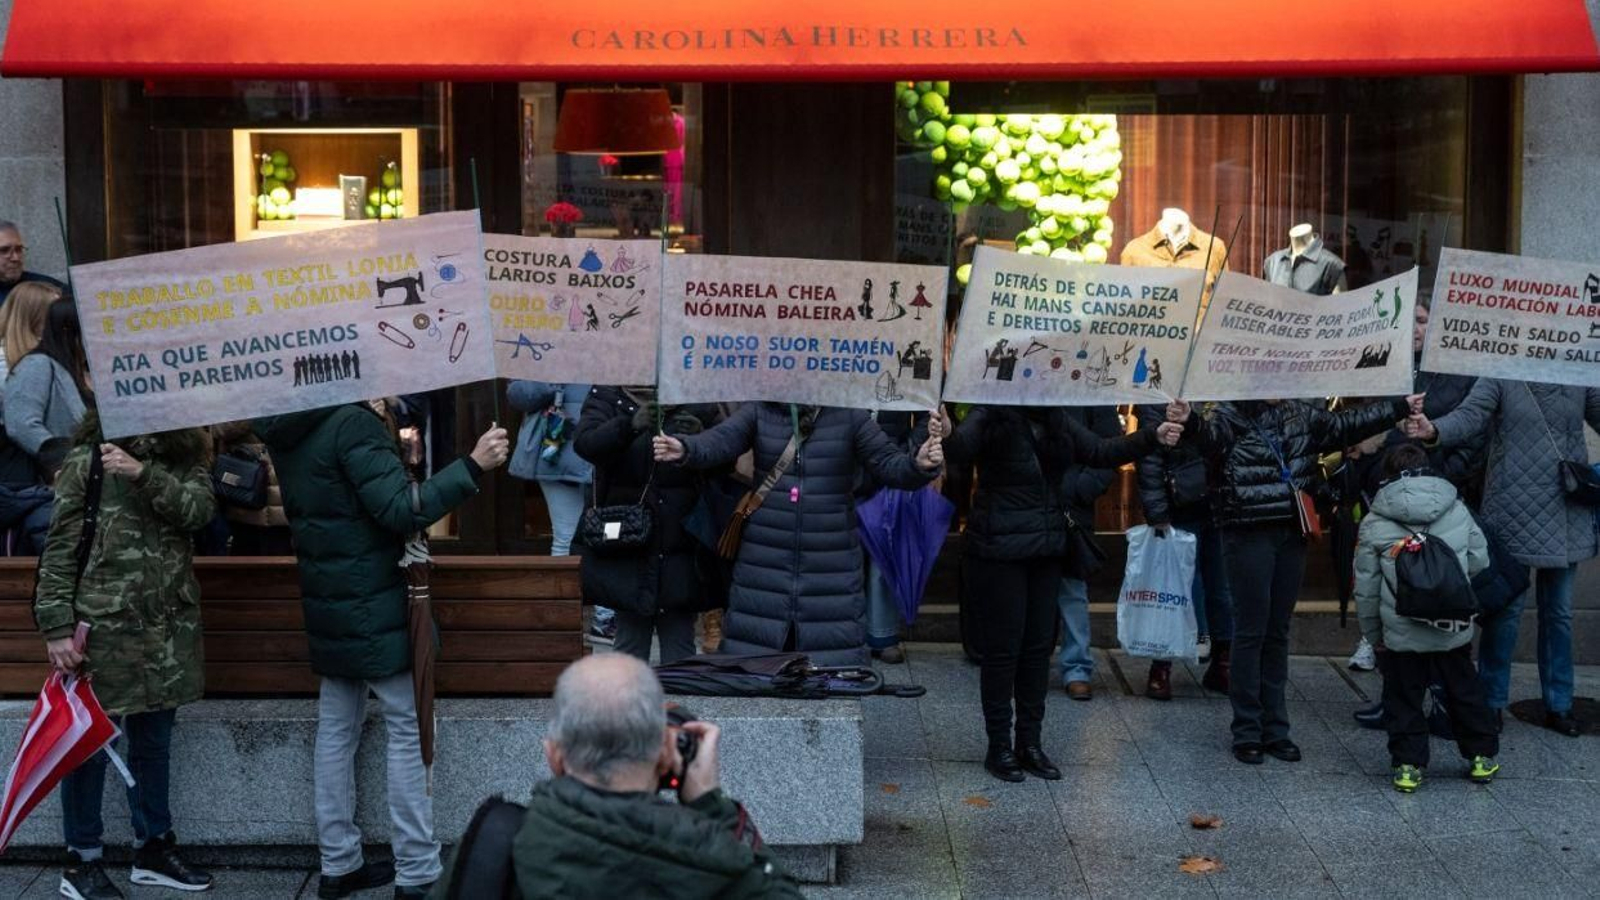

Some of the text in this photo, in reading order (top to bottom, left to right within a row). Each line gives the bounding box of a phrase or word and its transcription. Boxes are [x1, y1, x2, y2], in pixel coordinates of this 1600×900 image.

[572, 26, 1029, 50] CAROLINA HERRERA
[484, 249, 572, 268] COSTURA
[96, 252, 418, 310] TRABALLO EN TEXTIL LONIA
[485, 265, 636, 290] LARIOS BAIXOS
[995, 272, 1179, 302] DETRÁS DE CADA PEZA
[1450, 272, 1580, 299] LUXO MUNDIAL
[685, 281, 837, 301] PASARELA CHEA
[1447, 290, 1600, 318] EXPLOTACIÓN LAB
[103, 316, 115, 335] E
[246, 297, 262, 315] A
[273, 280, 371, 310] NÓMINA
[684, 299, 856, 321] NÓMINA BALEIRA
[991, 292, 1166, 319] HAI MANS CANSADAS
[1226, 298, 1373, 326] ELEGANTES POR FORA
[988, 311, 1188, 340] E DEREITOS RECORTADOS
[1221, 314, 1389, 339] MISERABLES POR DENTRO
[1442, 317, 1581, 344] VIDAS EN SALDO
[112, 323, 358, 374] ATA QUE AVANCEMOS
[681, 335, 894, 356] O NOSO SUOR TAMÉN
[1211, 343, 1259, 356] TEMOS
[1440, 336, 1518, 355] SALARIOS
[1525, 346, 1557, 360] SEN
[683, 352, 880, 374] É PARTE DO DESEÑO
[1240, 360, 1284, 374] TEMOS
[1287, 359, 1350, 373] DEREITOS
[114, 358, 283, 397] NON PAREMOS
